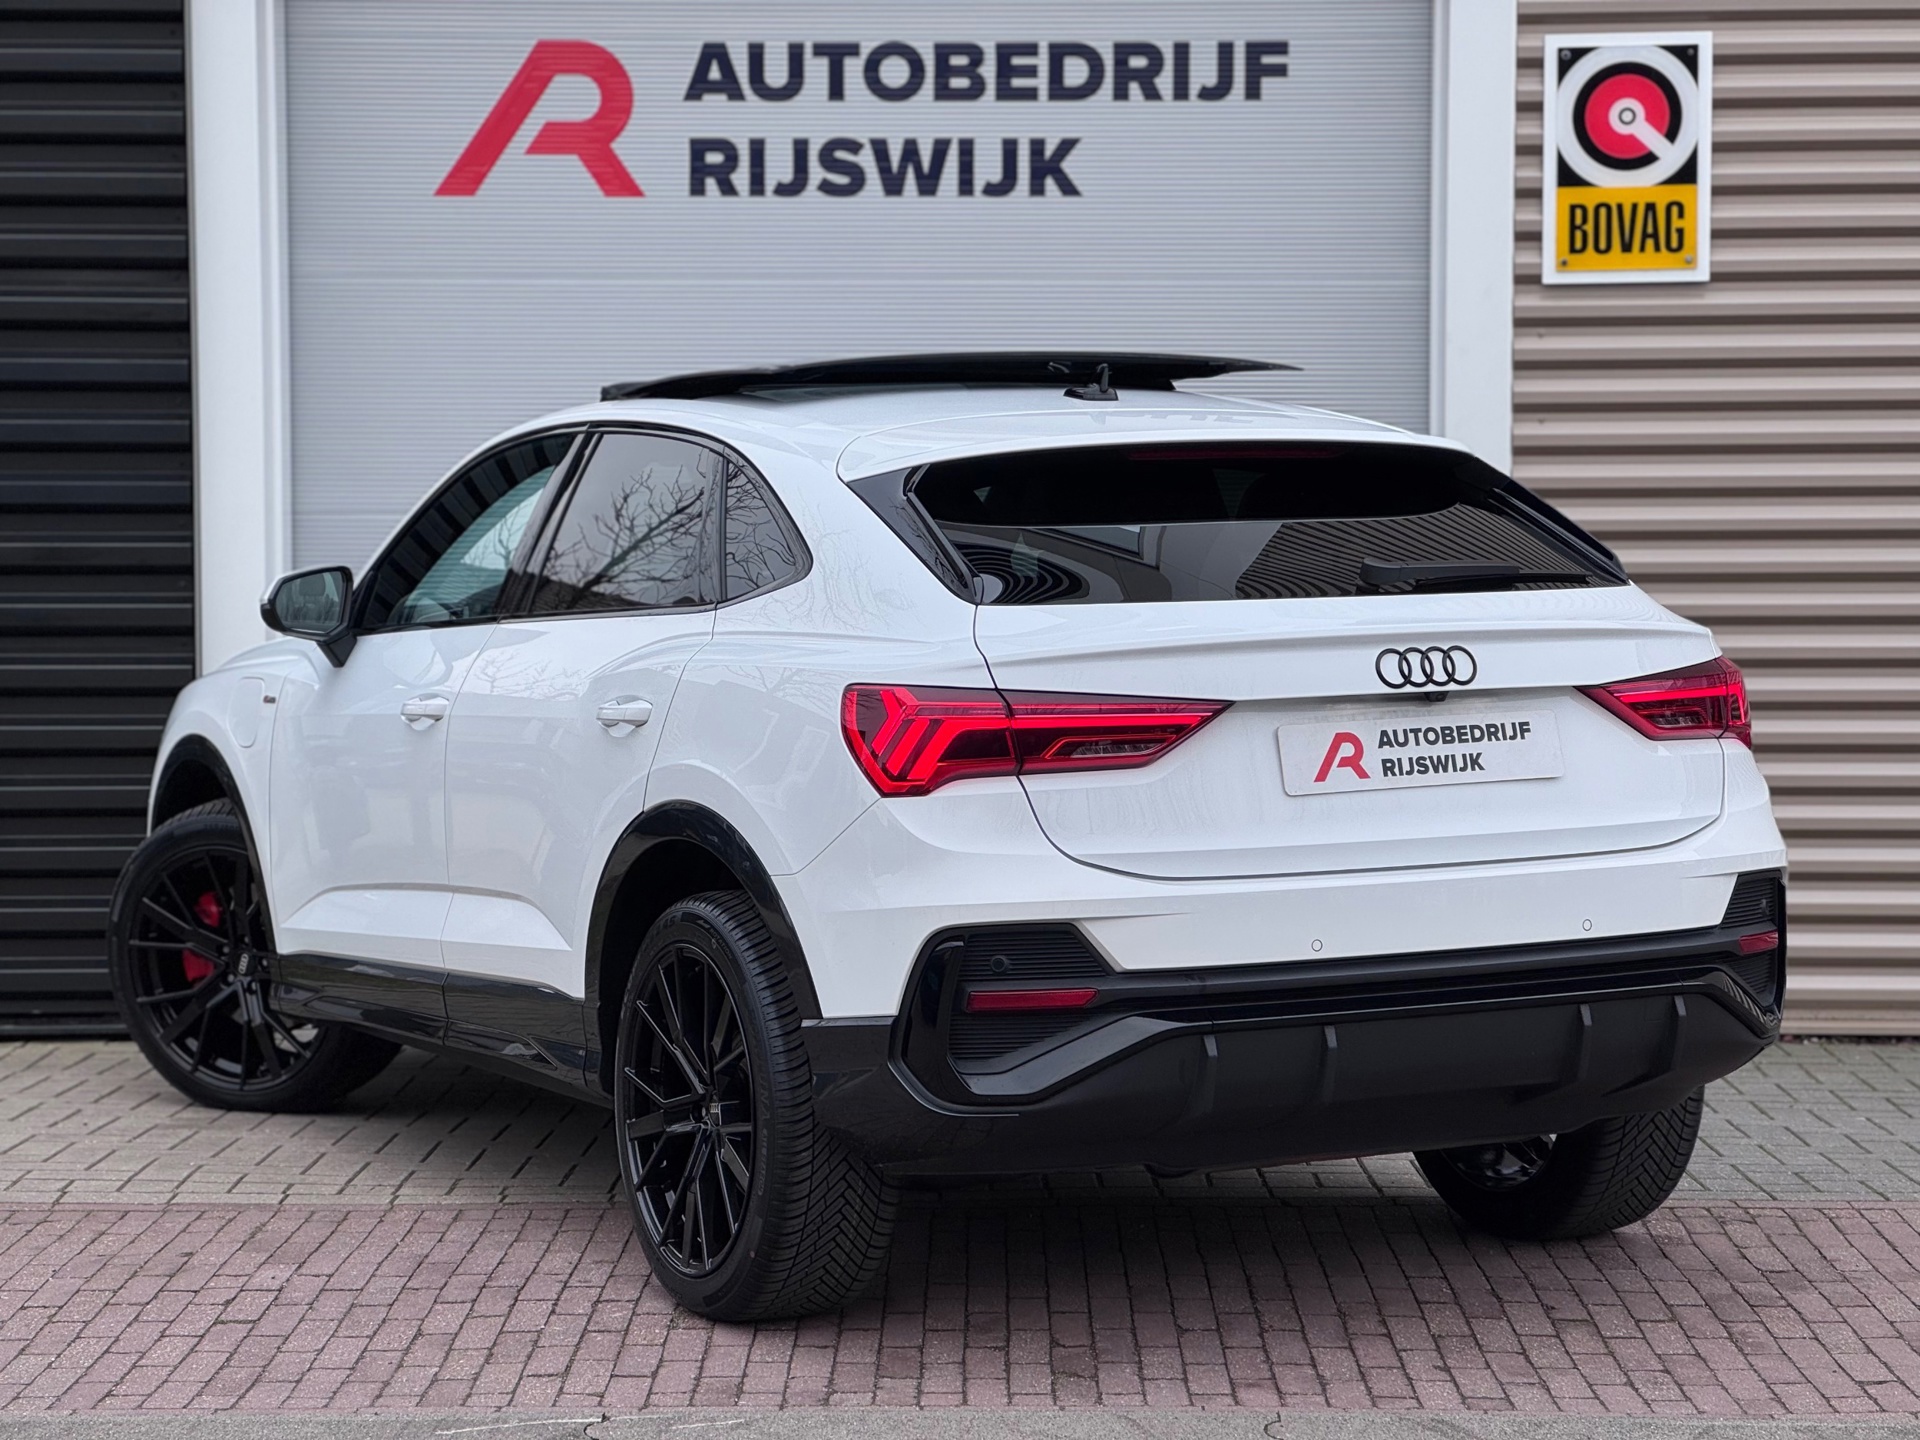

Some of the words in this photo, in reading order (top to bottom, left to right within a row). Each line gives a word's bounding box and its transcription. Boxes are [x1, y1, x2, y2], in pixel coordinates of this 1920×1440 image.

[683, 40, 1290, 103] AUTOBEDRIJF
[689, 137, 1083, 198] RIJSWIJK
[1568, 200, 1685, 255] BOVAG
[1377, 721, 1532, 749] AUTOBEDRIJF
[1380, 752, 1486, 778] RIJSWIJK
